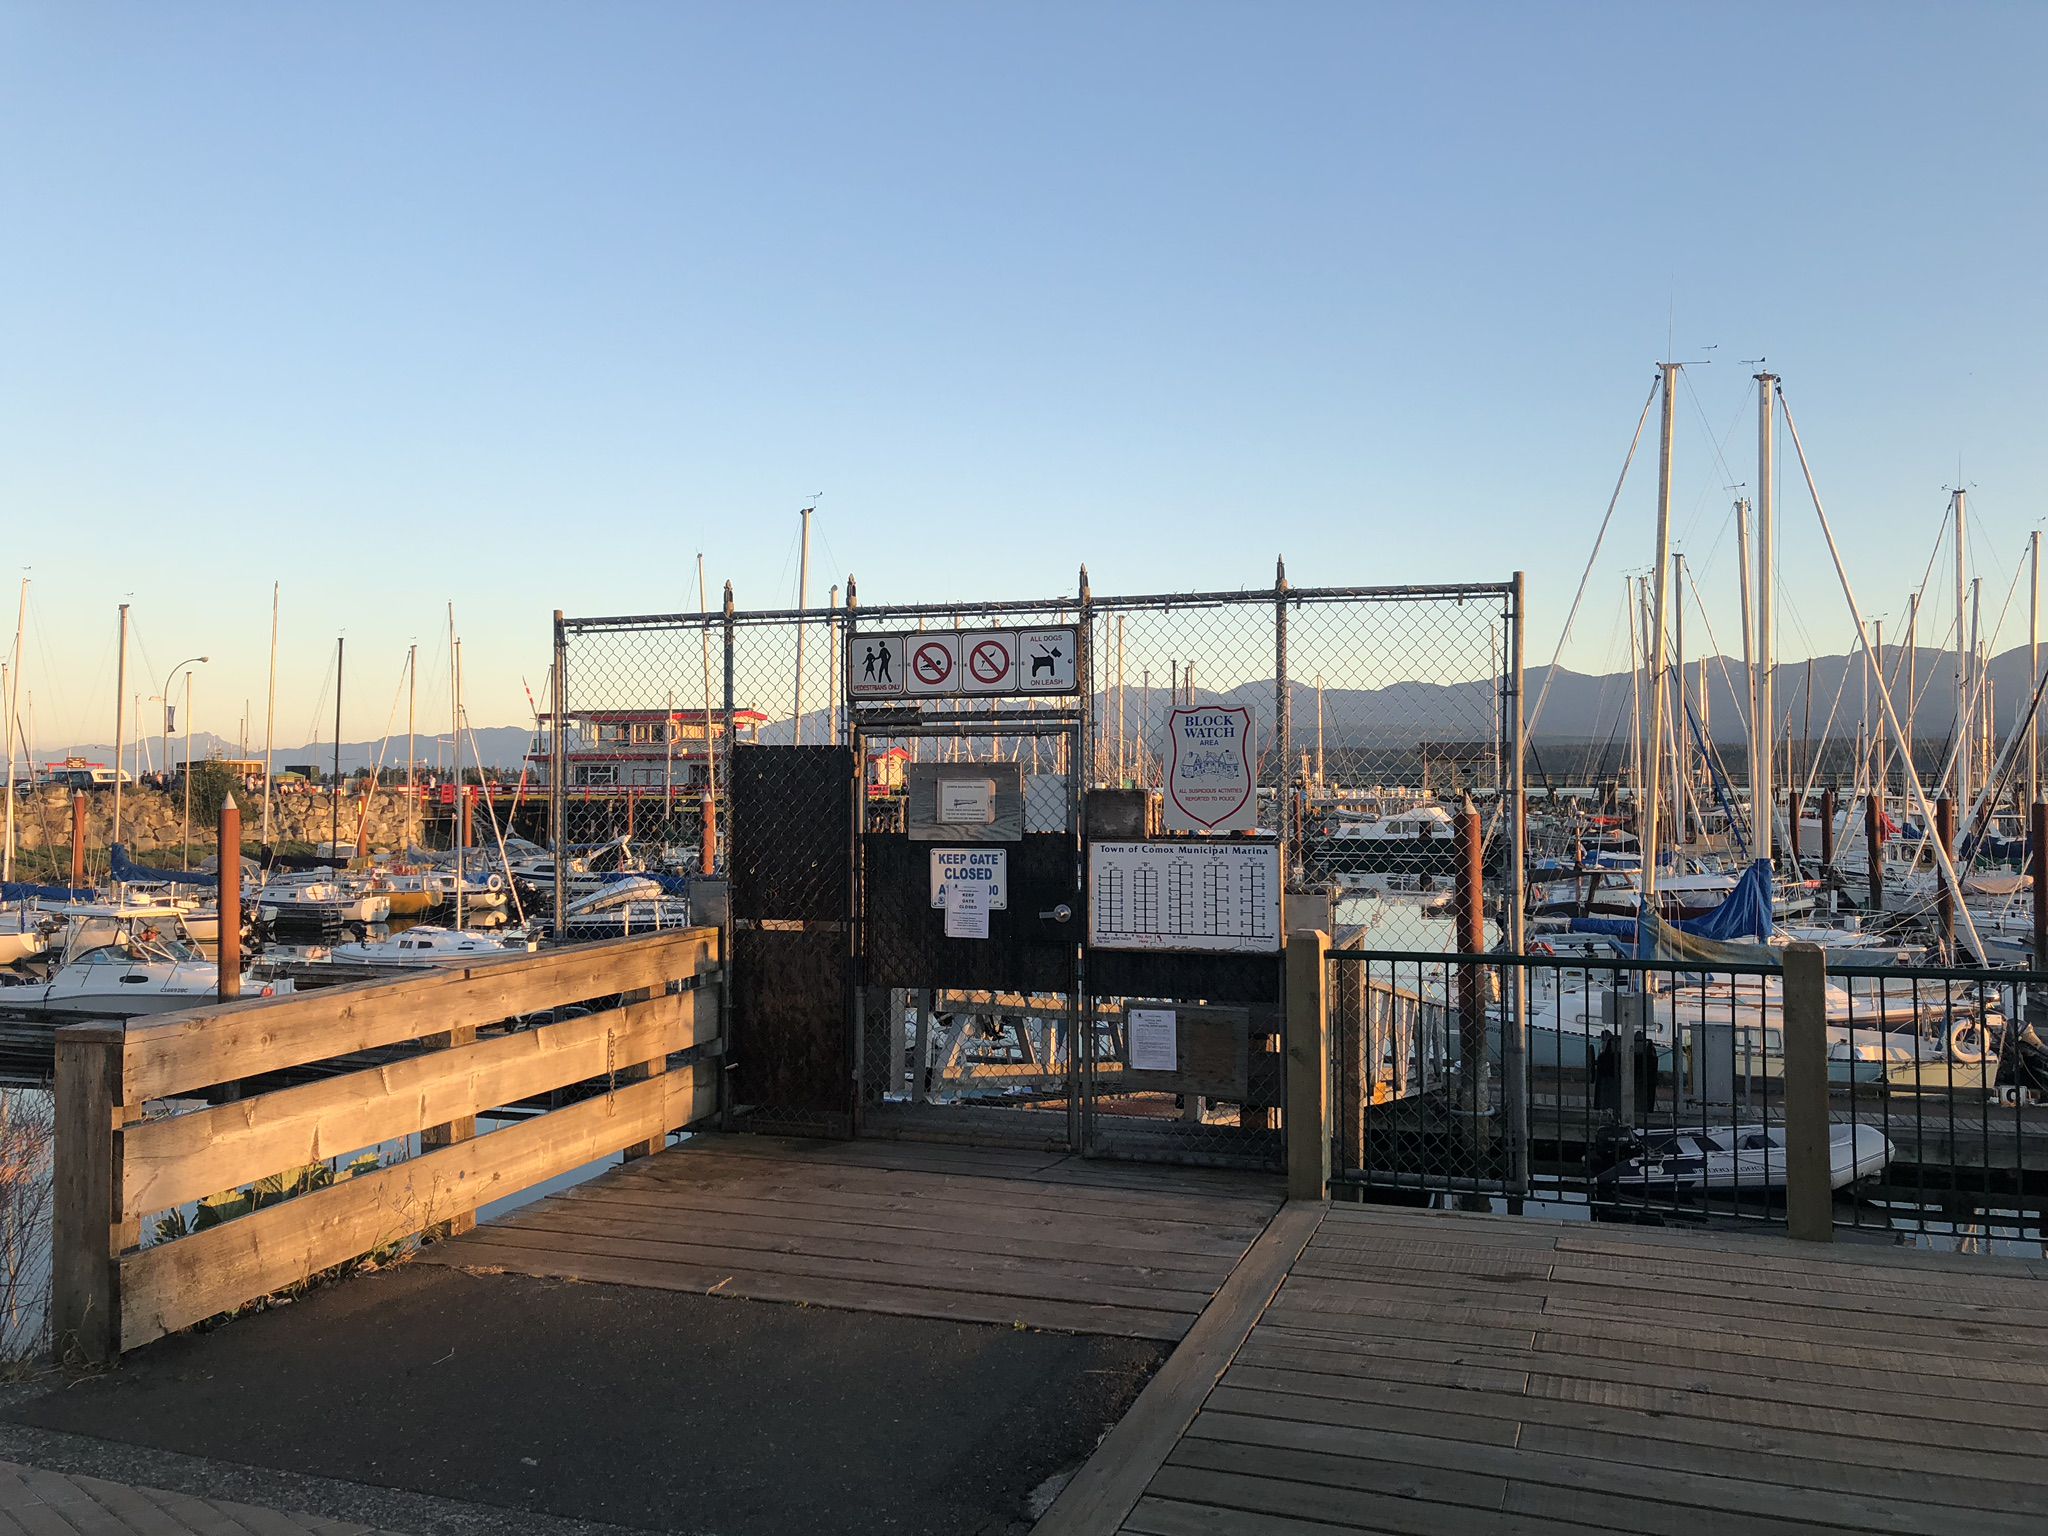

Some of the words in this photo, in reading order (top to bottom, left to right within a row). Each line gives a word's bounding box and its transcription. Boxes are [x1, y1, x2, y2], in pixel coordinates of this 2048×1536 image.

[1043, 634, 1063, 642] DOGS
[1041, 678, 1064, 686] LEASH
[1185, 715, 1234, 727] BLOCK
[1184, 727, 1235, 738] WATCH
[1101, 845, 1125, 853] Town
[1128, 845, 1138, 853] of
[1141, 845, 1175, 854] Comox
[1178, 846, 1228, 856] Municipal
[1232, 847, 1269, 855] Marina
[938, 854, 967, 865] KEEP
[969, 854, 999, 865] GATE
[944, 867, 993, 880] CLOSED
